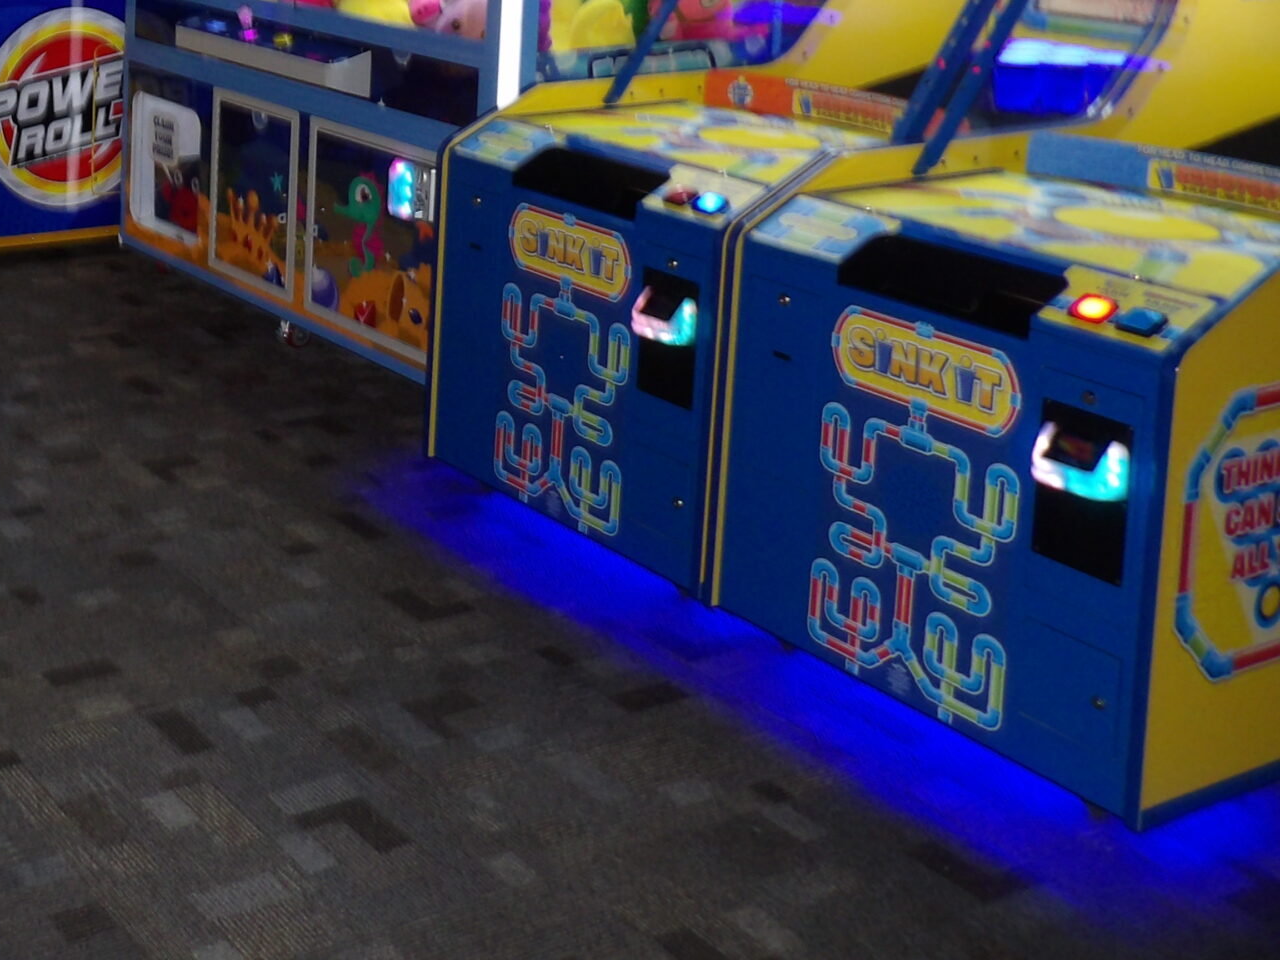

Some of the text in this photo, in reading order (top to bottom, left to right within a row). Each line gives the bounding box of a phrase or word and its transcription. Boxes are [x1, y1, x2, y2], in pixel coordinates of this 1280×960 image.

[12, 102, 121, 165] ROLL
[1222, 448, 1280, 494] THIN
[1224, 494, 1274, 537] CAN
[1230, 540, 1270, 580] ALL
